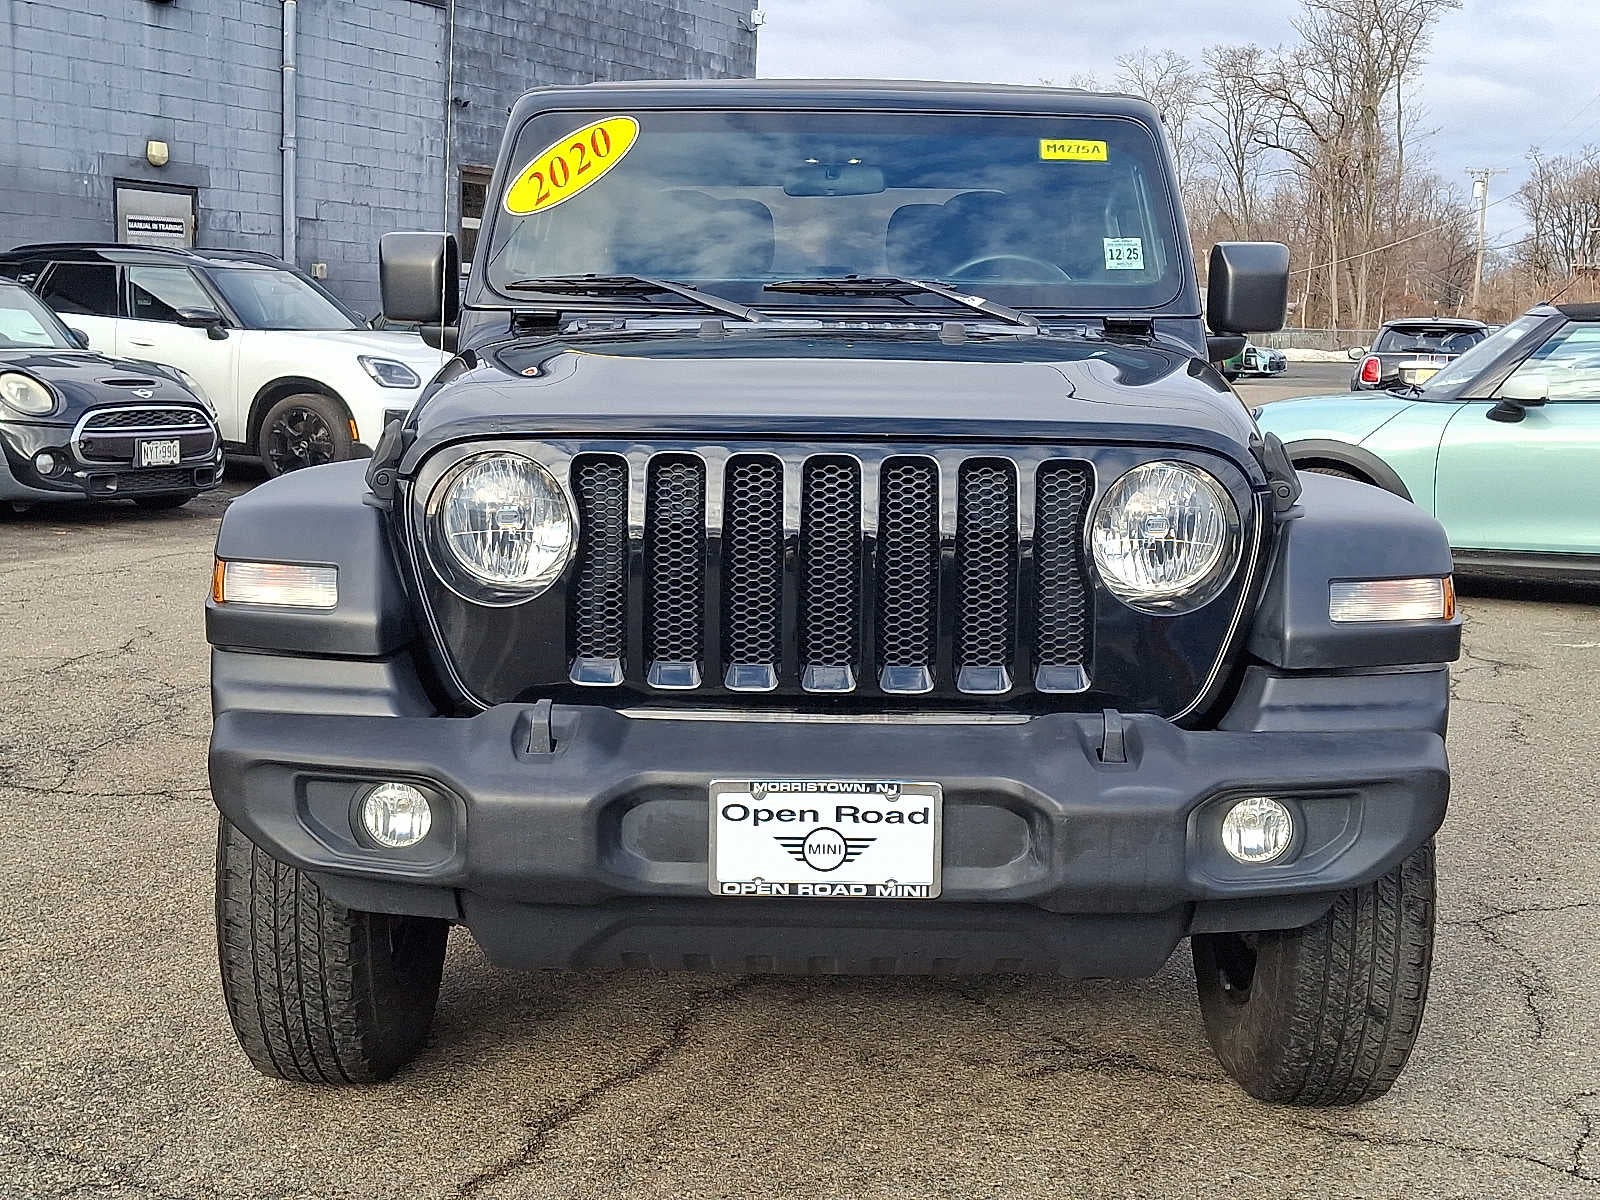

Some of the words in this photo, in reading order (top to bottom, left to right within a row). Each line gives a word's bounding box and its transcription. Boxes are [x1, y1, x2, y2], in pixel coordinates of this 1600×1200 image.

[528, 127, 611, 206] 2020
[1108, 248, 1123, 260] 12
[1126, 247, 1139, 260] 25
[753, 782, 870, 793] MORRISTOWN,
[875, 783, 898, 793] NJ
[722, 804, 819, 826] Open
[835, 806, 929, 824] Road
[808, 844, 842, 855] MINI
[721, 882, 789, 895] OPEN
[797, 883, 868, 896] ROAD
[875, 884, 928, 897] MINI
